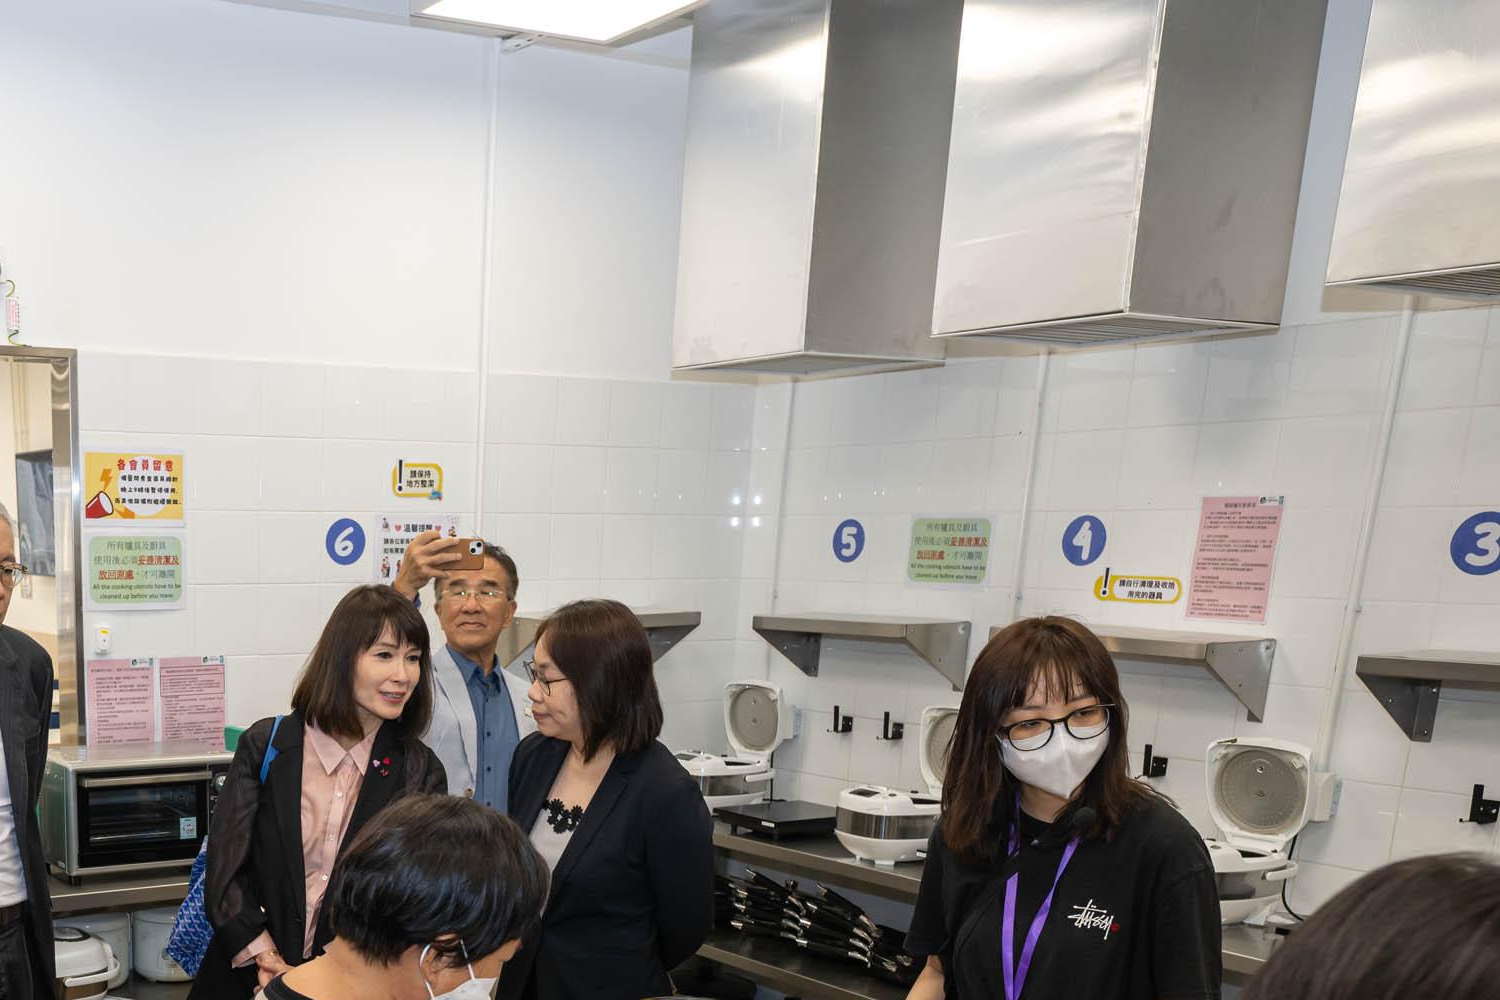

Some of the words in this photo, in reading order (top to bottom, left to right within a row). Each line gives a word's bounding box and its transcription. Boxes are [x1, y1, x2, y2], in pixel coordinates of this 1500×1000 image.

[117, 458, 173, 472] 各會員留意
[410, 470, 431, 478] 請保持
[406, 480, 435, 488] 地方整潔
[334, 526, 355, 557] 6
[841, 526, 858, 557] 5
[1072, 520, 1093, 561] 4
[1465, 521, 1500, 567] 3
[1118, 579, 1175, 590] 請自行清理及收拾
[1127, 591, 1163, 600] 用完的器具
